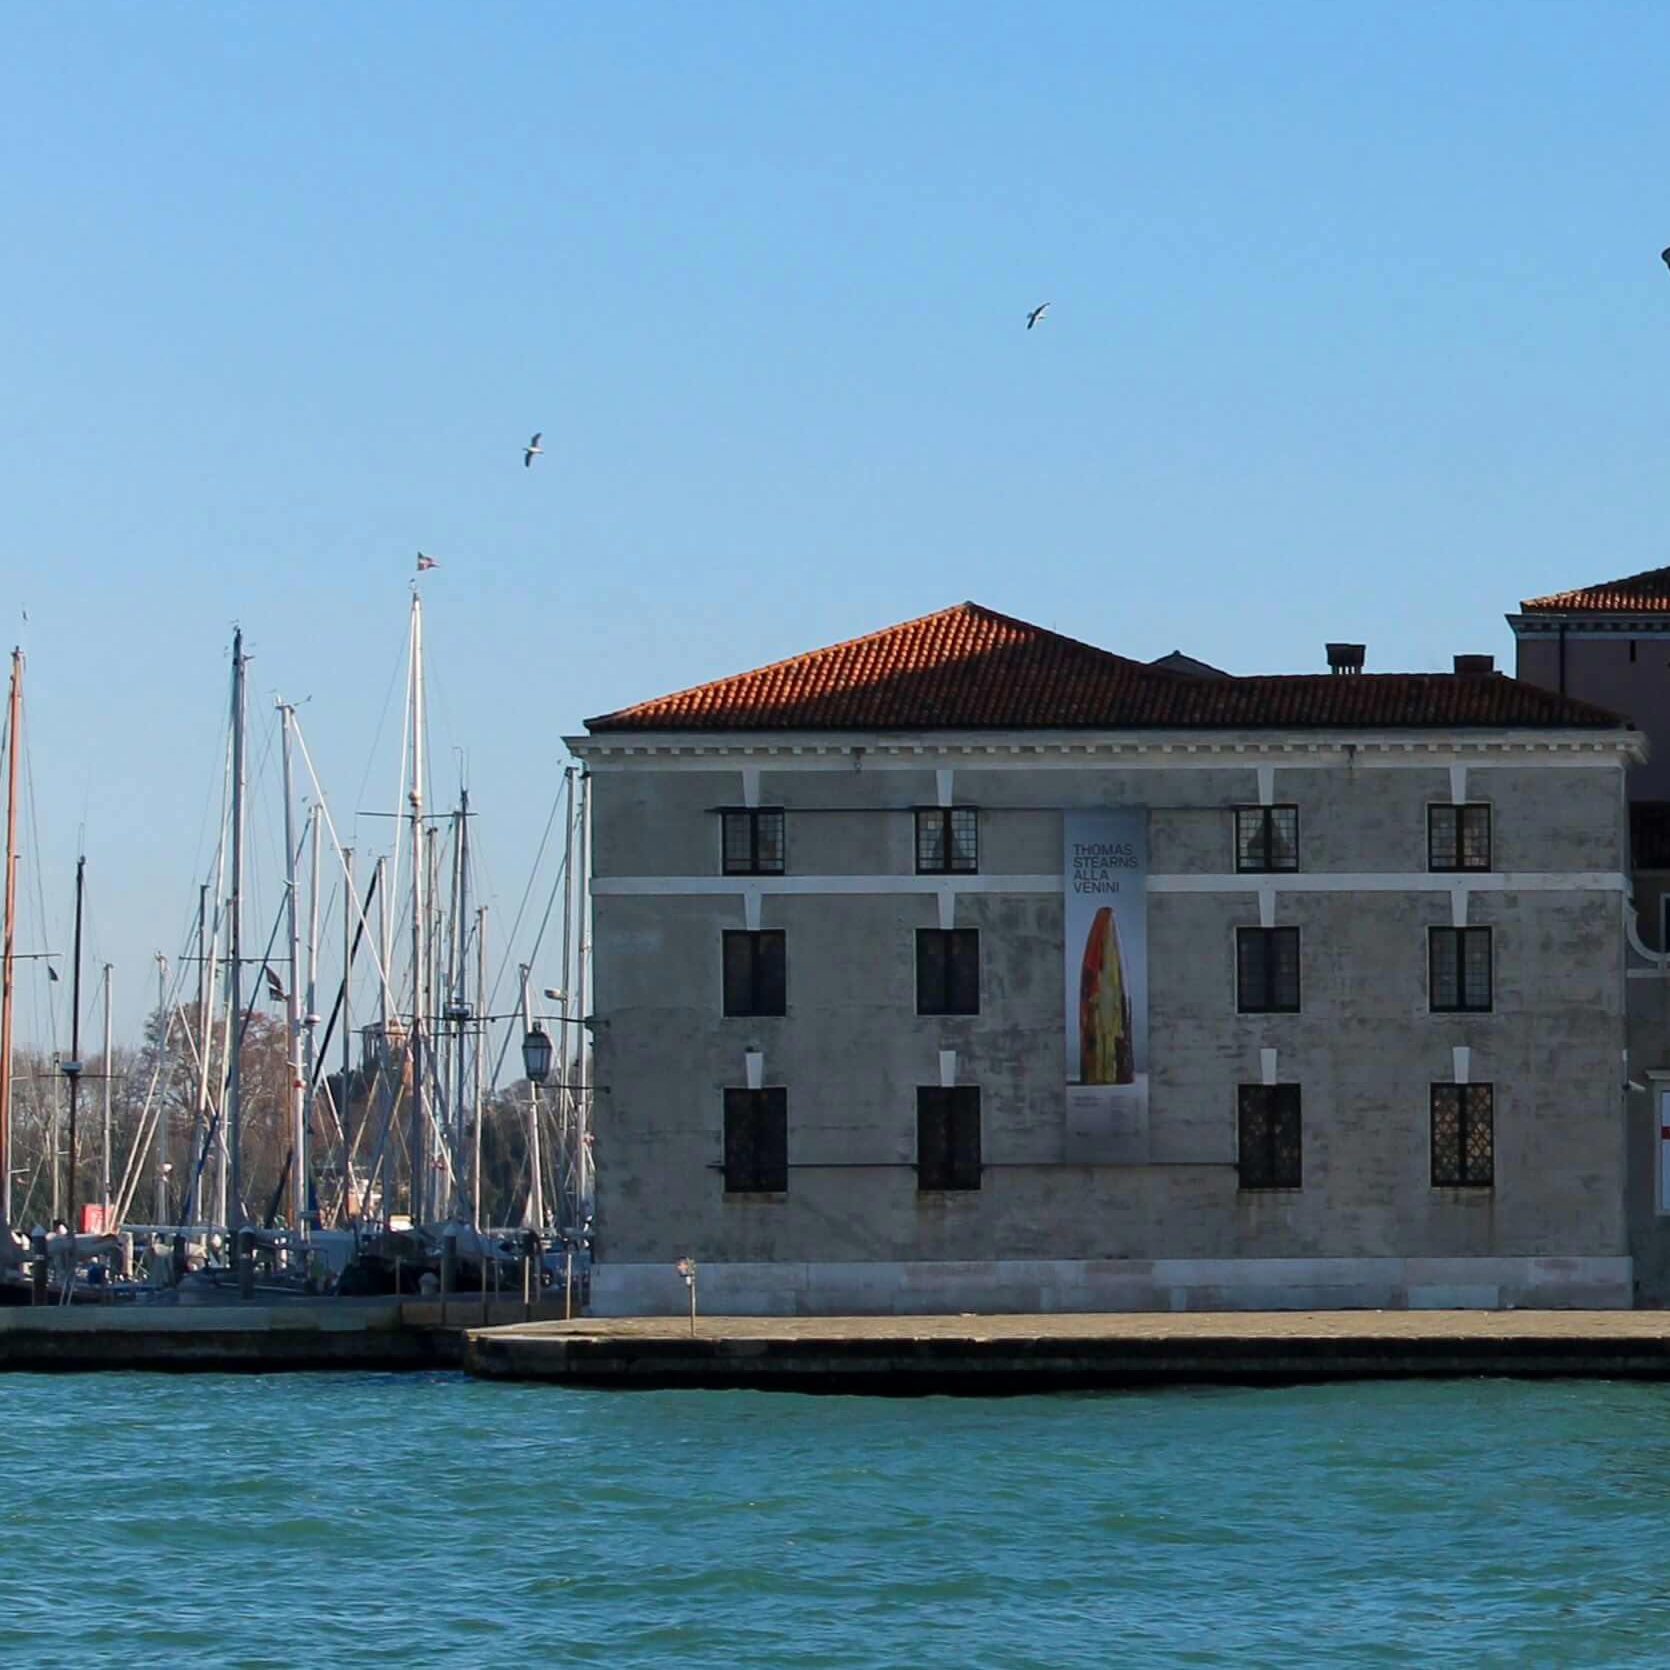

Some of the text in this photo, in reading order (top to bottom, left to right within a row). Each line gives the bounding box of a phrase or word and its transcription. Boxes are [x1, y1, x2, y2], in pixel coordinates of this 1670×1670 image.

[1073, 843, 1133, 856] THOMAS
[1073, 856, 1138, 868] STEARNS
[1074, 869, 1109, 881] ALLA
[1073, 881, 1120, 894] VENINI
